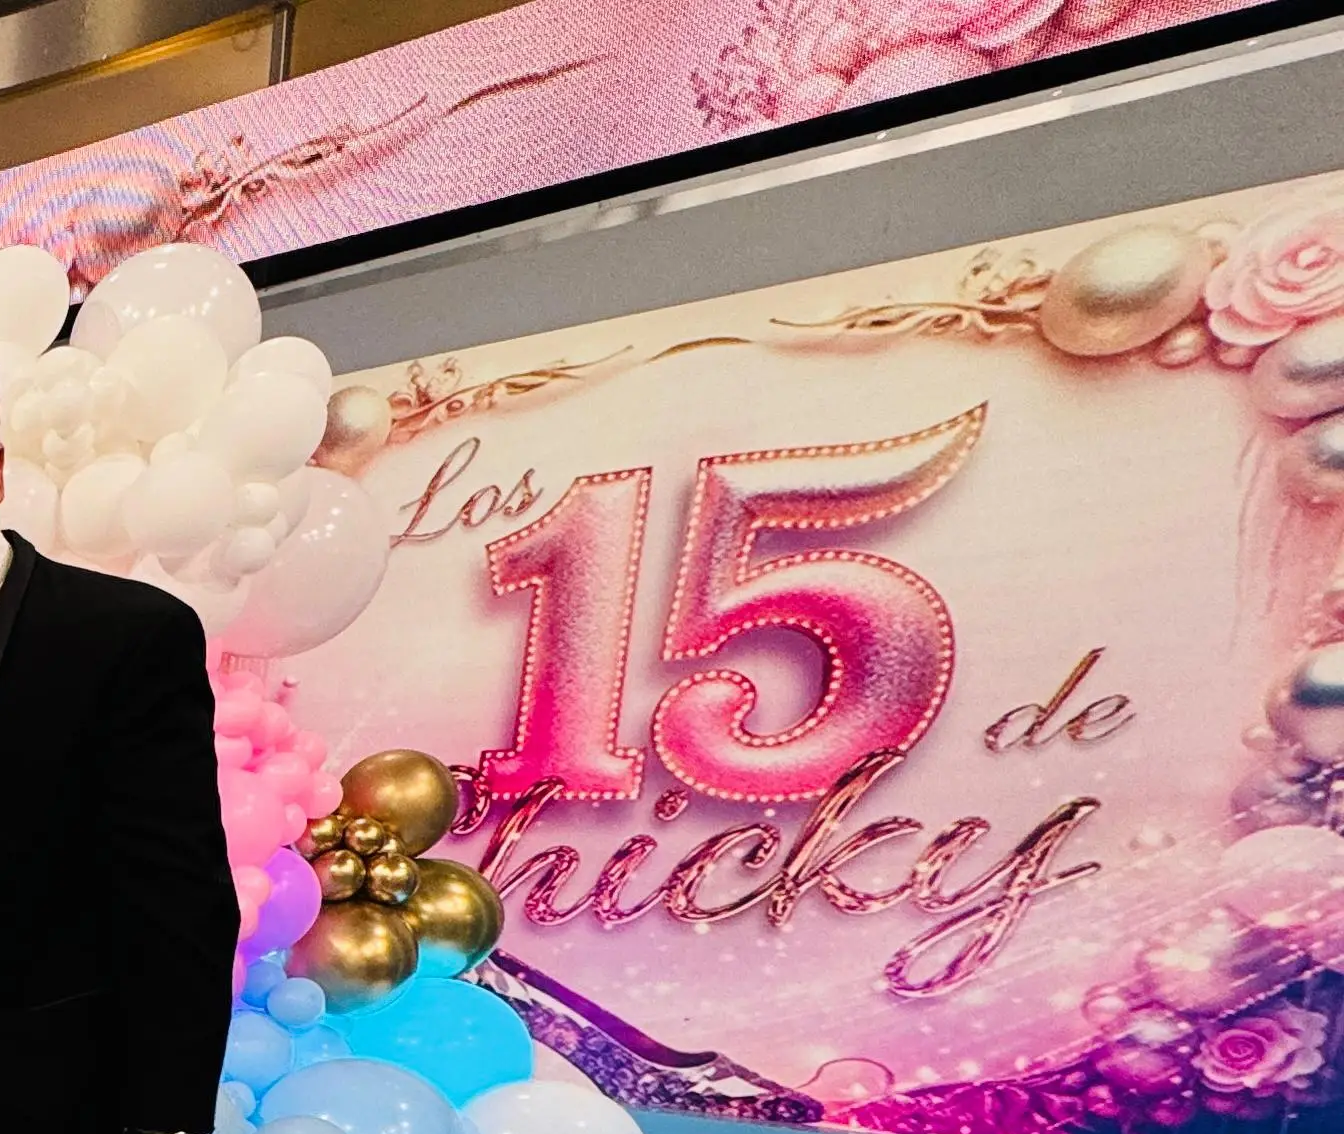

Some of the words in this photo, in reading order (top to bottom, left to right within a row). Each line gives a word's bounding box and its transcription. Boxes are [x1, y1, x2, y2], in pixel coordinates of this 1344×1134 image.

[390, 436, 544, 549] Los
[480, 402, 989, 801] 15
[984, 646, 1137, 753] de
